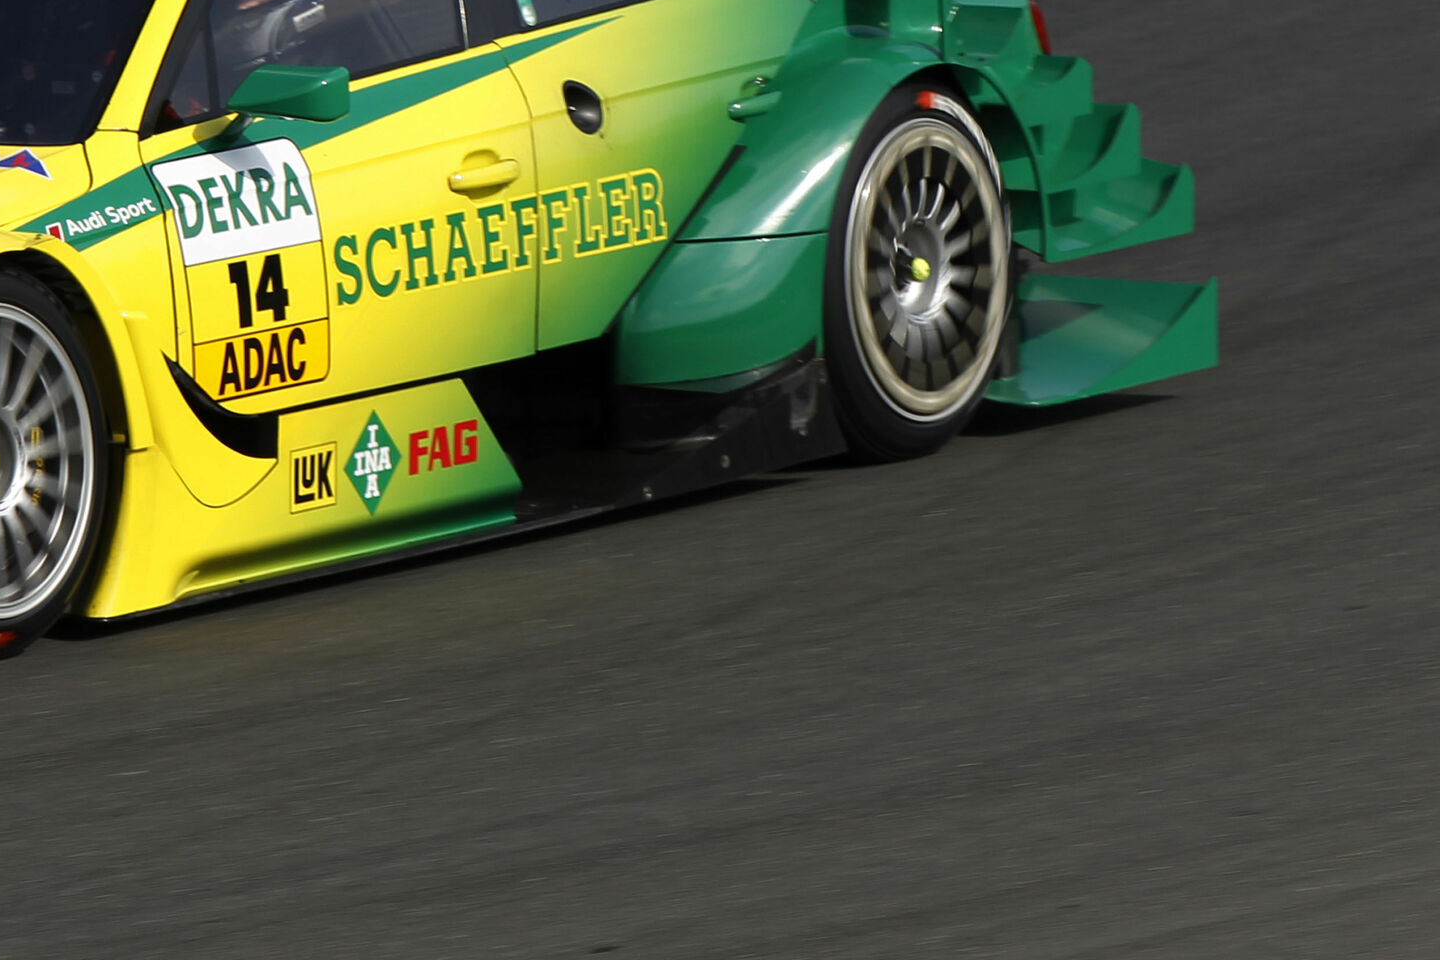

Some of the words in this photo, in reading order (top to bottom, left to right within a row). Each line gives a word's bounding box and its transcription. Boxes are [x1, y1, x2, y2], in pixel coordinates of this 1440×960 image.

[66, 211, 107, 236] Audi
[104, 196, 158, 226] Sport
[167, 161, 314, 240] DEKRA
[333, 167, 668, 306] SCHAEFFLER
[227, 253, 290, 329] 14
[218, 327, 307, 396] ADAC
[408, 419, 478, 476] FAG
